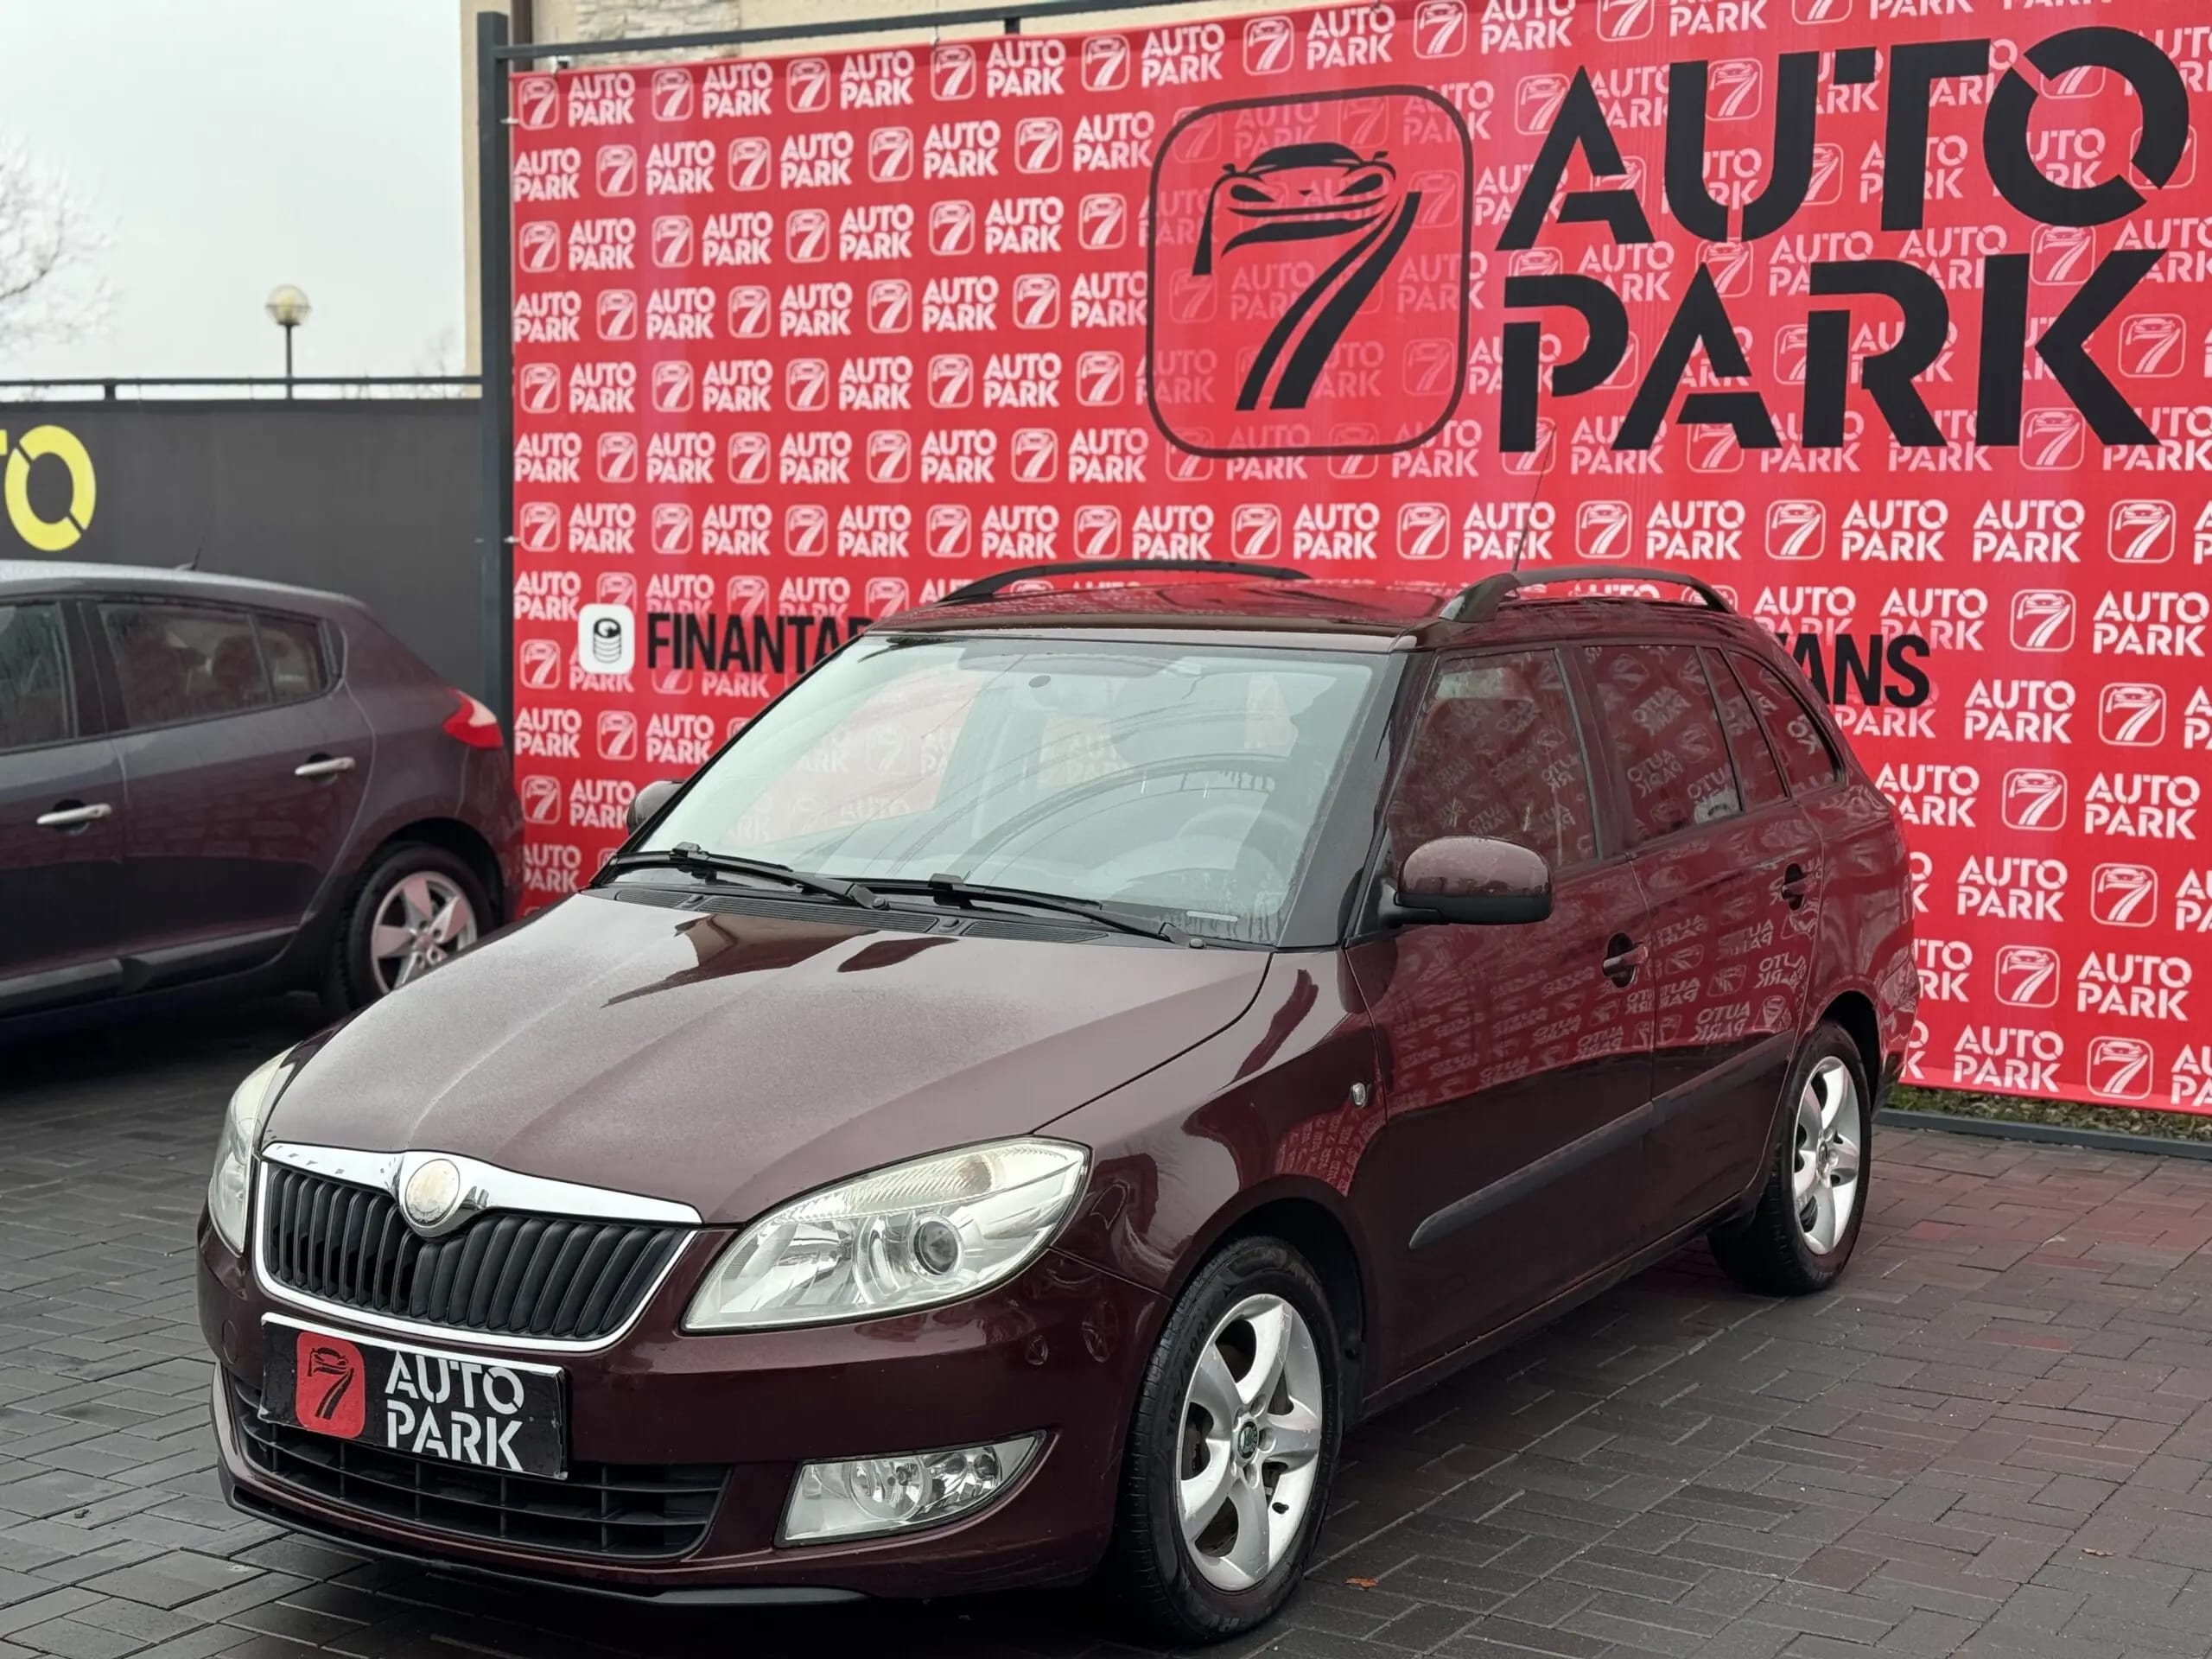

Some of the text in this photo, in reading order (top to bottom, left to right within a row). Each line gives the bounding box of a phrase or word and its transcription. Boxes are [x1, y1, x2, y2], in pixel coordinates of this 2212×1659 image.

[1306, 3, 1395, 41] AUTO
[1670, 3, 1768, 37] PARK
[1141, 23, 1224, 60] AUTO
[1307, 33, 1392, 70] PARK
[1482, 23, 1571, 54] PARK
[839, 50, 914, 82] AUTO
[986, 39, 1065, 70] AUTO
[702, 61, 772, 92] AUTO
[987, 67, 1064, 97] PARK
[1142, 52, 1222, 87] PARK
[569, 72, 635, 101] AUTO
[841, 77, 912, 109] PARK
[569, 96, 633, 127] PARK
[702, 88, 772, 118] PARK
[924, 120, 1000, 152] AUTO
[1073, 111, 1154, 144] AUTO
[1496, 26, 2190, 251] AUTO
[646, 140, 715, 168] AUTO
[780, 131, 854, 162] AUTO
[1074, 140, 1152, 171] PARK
[514, 147, 581, 177] AUTO
[781, 157, 851, 188] PARK
[924, 147, 998, 179] PARK
[514, 172, 579, 202] PARK
[646, 166, 713, 195] PARK
[702, 212, 772, 240] AUTO
[839, 204, 913, 234] AUTO
[985, 197, 1064, 226] AUTO
[569, 218, 636, 245] AUTO
[840, 230, 912, 260] PARK
[986, 225, 1061, 253] PARK
[1898, 225, 2007, 259] AUTO
[569, 244, 633, 270] PARK
[703, 238, 771, 266] PARK
[1578, 241, 1675, 274] AUTO
[1769, 231, 1874, 264] AUTO
[923, 276, 999, 305] AUTO
[1071, 271, 1147, 300] AUTO
[1230, 261, 1315, 294] AUTO
[514, 291, 581, 317] AUTO
[646, 287, 715, 314] AUTO
[780, 283, 852, 311] AUTO
[646, 313, 713, 340] PARK
[780, 308, 850, 337] PARK
[923, 303, 995, 332] PARK
[1071, 299, 1147, 327] PARK
[514, 316, 579, 342] PARK
[1502, 249, 2167, 453] PARK
[569, 362, 636, 388] AUTO
[702, 359, 772, 386] AUTO
[839, 356, 912, 384] AUTO
[983, 353, 1061, 380] AUTO
[570, 387, 634, 412] PARK
[703, 385, 771, 411] PARK
[839, 382, 910, 410] PARK
[984, 379, 1058, 407] PARK
[514, 433, 582, 457] AUTO
[647, 432, 715, 458] AUTO
[780, 431, 852, 458] AUTO
[921, 429, 996, 456] AUTO
[1069, 429, 1148, 455] AUTO
[515, 457, 579, 482] PARK
[647, 457, 713, 483] PARK
[780, 457, 849, 484] PARK
[921, 456, 994, 482] PARK
[1069, 455, 1145, 482] PARK
[1225, 454, 1308, 480] PARK
[1392, 448, 1479, 478] PARK
[1571, 445, 1663, 474] PARK
[1761, 442, 1860, 473] PARK
[1888, 442, 1993, 472] PARK
[569, 503, 636, 527] AUTO
[702, 505, 772, 530] AUTO
[838, 505, 911, 531] AUTO
[982, 505, 1058, 532] AUTO
[1133, 505, 1213, 532] AUTO
[1294, 503, 1379, 531] AUTO
[1464, 502, 1555, 530] AUTO
[1647, 500, 1745, 529] AUTO
[1842, 499, 1948, 530] AUTO
[1974, 499, 2084, 530] AUTO
[569, 527, 633, 553] PARK
[702, 529, 770, 556] PARK
[838, 531, 908, 556] PARK
[982, 532, 1056, 559] PARK
[1133, 531, 1211, 560] PARK
[1294, 531, 1376, 559] PARK
[1464, 531, 1552, 560] PARK
[1647, 531, 1742, 559] PARK
[1842, 531, 1944, 561] PARK
[1974, 531, 2081, 563] PARK
[514, 571, 582, 598] AUTO
[645, 574, 715, 601] AUTO
[778, 576, 851, 606] AUTO
[514, 595, 580, 621] PARK
[1753, 587, 1857, 617] AUTO
[1880, 588, 1988, 619] AUTO
[2094, 591, 2209, 624] AUTO
[2094, 623, 2207, 657] PARK
[569, 671, 634, 693] PARK
[1776, 632, 1930, 708] ANS
[702, 672, 770, 698] PARK
[1965, 679, 2075, 711] AUTO
[514, 708, 582, 733] AUTO
[646, 714, 714, 740] AUTO
[1834, 705, 1936, 739] PARK
[1965, 710, 2071, 743] PARK
[515, 731, 579, 758] PARK
[646, 738, 712, 764] PARK
[569, 779, 637, 805] AUTO
[1875, 763, 1980, 796] AUTO
[2085, 772, 2201, 808] AUTO
[2085, 804, 2196, 840] PARK
[1958, 855, 2067, 889] AUTO
[1958, 886, 2063, 921] PARK
[2078, 952, 2192, 988] AUTO
[2078, 982, 2189, 1021] PARK
[1955, 1026, 2064, 1060] AUTO
[1954, 1055, 2061, 1092] PARK
[385, 1350, 524, 1414] AUTO
[387, 1399, 524, 1471] PARK
